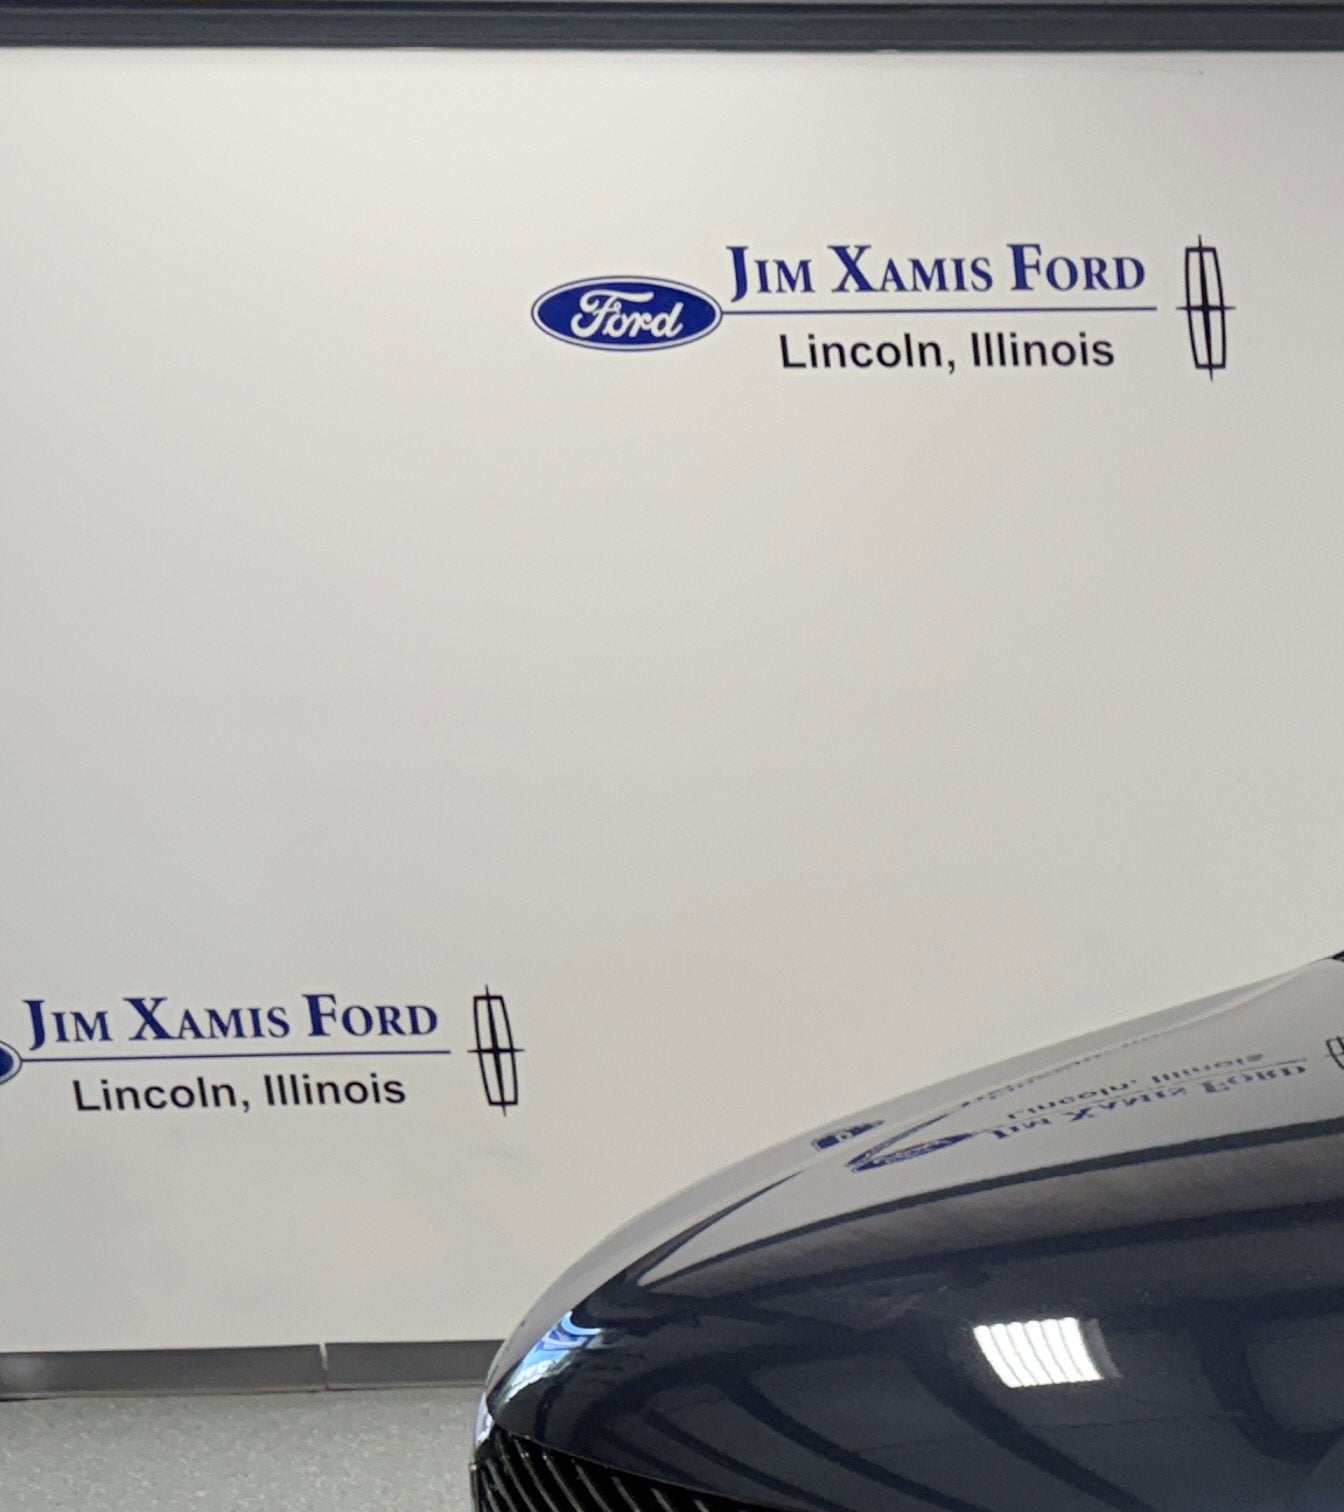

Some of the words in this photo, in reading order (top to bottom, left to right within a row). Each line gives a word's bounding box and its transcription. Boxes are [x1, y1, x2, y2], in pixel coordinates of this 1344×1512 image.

[726, 244, 813, 302] JIM
[828, 243, 994, 294] XAMIS
[1006, 242, 1145, 292] FORD
[570, 287, 684, 340] Ford
[779, 332, 956, 376] Lincoln,
[972, 330, 1115, 368] Illinois
[22, 999, 114, 1052] JIM
[123, 997, 291, 1042] XAMIS
[301, 993, 438, 1038] FORD
[73, 1075, 251, 1113] Lincoln,
[264, 1072, 406, 1106] Illinois
